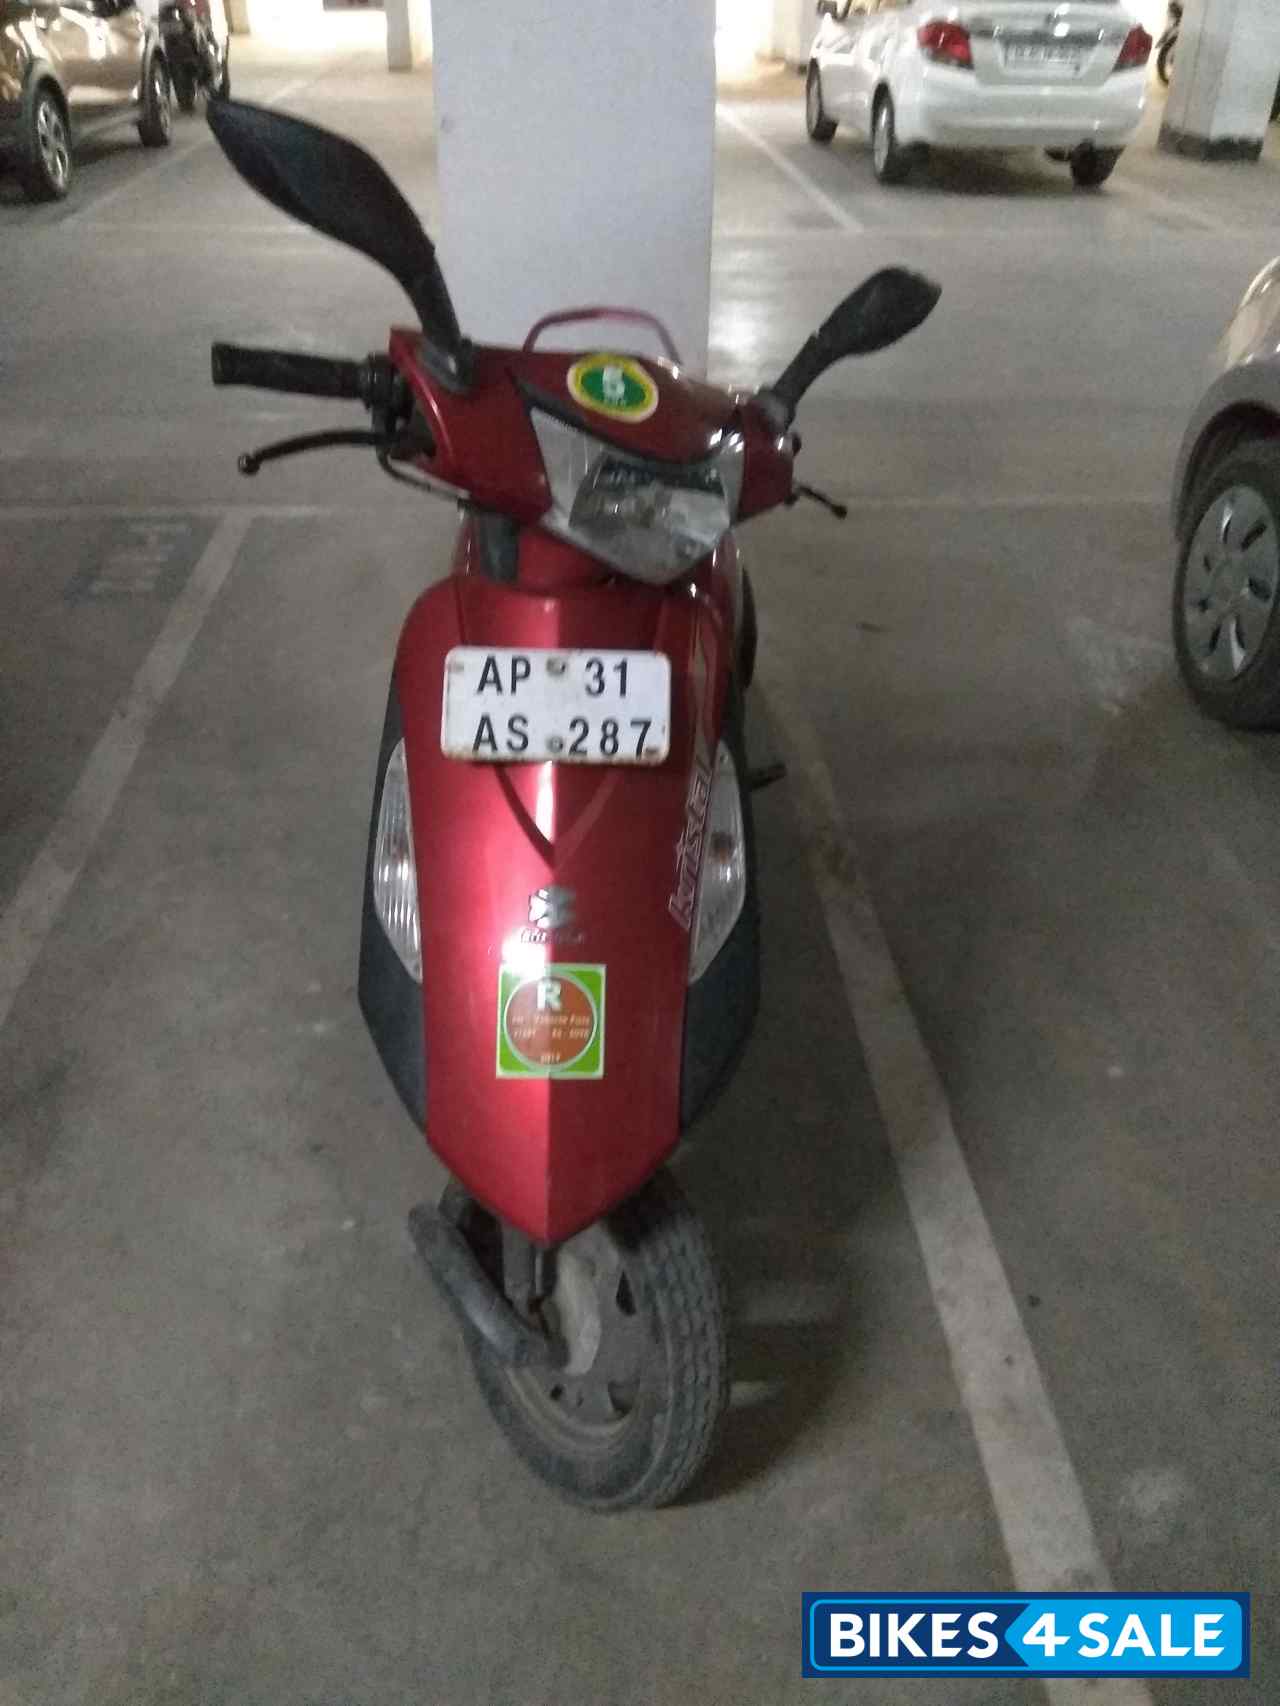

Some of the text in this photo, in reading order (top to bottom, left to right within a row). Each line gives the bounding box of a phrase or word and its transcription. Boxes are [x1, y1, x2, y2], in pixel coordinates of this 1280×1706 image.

[476, 655, 628, 697] AP 31
[472, 714, 652, 758] AS 287
